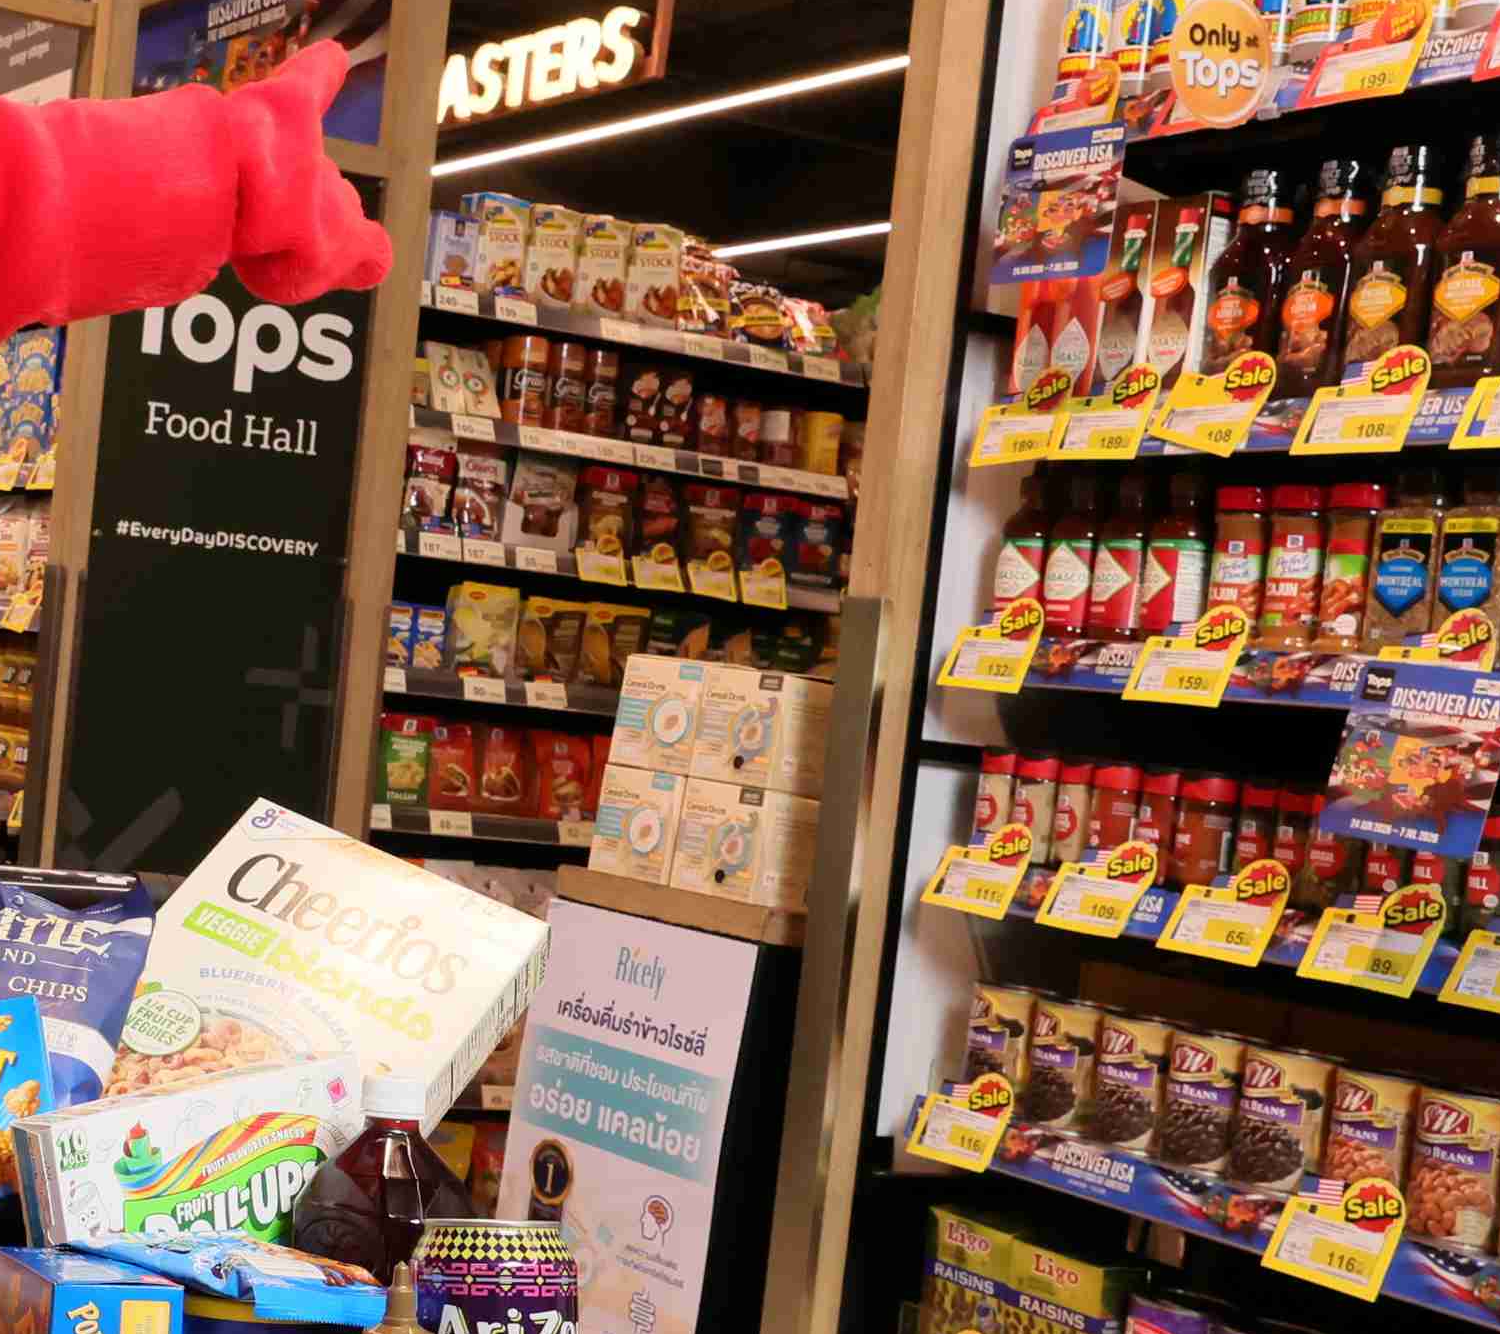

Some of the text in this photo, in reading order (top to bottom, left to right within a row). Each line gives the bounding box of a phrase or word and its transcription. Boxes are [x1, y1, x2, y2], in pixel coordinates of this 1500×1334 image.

[1189, 23, 1241, 53] Only
[1179, 51, 1261, 98] Tops
[1358, 70, 1389, 90] 199
[1033, 143, 1113, 169] DISCOVER USA
[488, 231, 521, 244] STOCK
[538, 236, 569, 249] STOCK
[588, 246, 620, 259] STOCK
[640, 256, 675, 269] STOCK
[1113, 373, 1157, 401] Sale
[1224, 366, 1273, 389] Sale
[1370, 359, 1426, 388] Sale
[1027, 375, 1070, 407] Sale
[145, 401, 318, 458] Food Hall
[1206, 428, 1232, 444] 108
[1356, 422, 1385, 440] 108
[116, 519, 320, 558] #EveryDayDISCOVERY
[1000, 609, 1042, 633] Sale
[1197, 617, 1246, 645] Sale
[1392, 687, 1466, 715] DISCOVER
[989, 835, 1030, 861] Sale
[1106, 853, 1154, 880] Sale
[226, 852, 468, 996] Cheerios
[1385, 899, 1442, 928] Sale
[197, 904, 270, 955] VEGGIE
[8, 973, 89, 1003] CHIPS
[616, 946, 666, 1001] Ricely
[529, 1081, 700, 1162] อร่อย แคลน้อย
[1054, 1142, 1136, 1183] DISCOVER USA
[176, 1193, 214, 1218] FRUIT
[1344, 1193, 1402, 1223] Sale
[946, 1221, 990, 1255] Ligo
[1031, 1253, 1080, 1286] Ligo
[1326, 1250, 1356, 1272] 116
[934, 1263, 995, 1295] RAISINS
[1018, 1294, 1087, 1330] RAISINS
